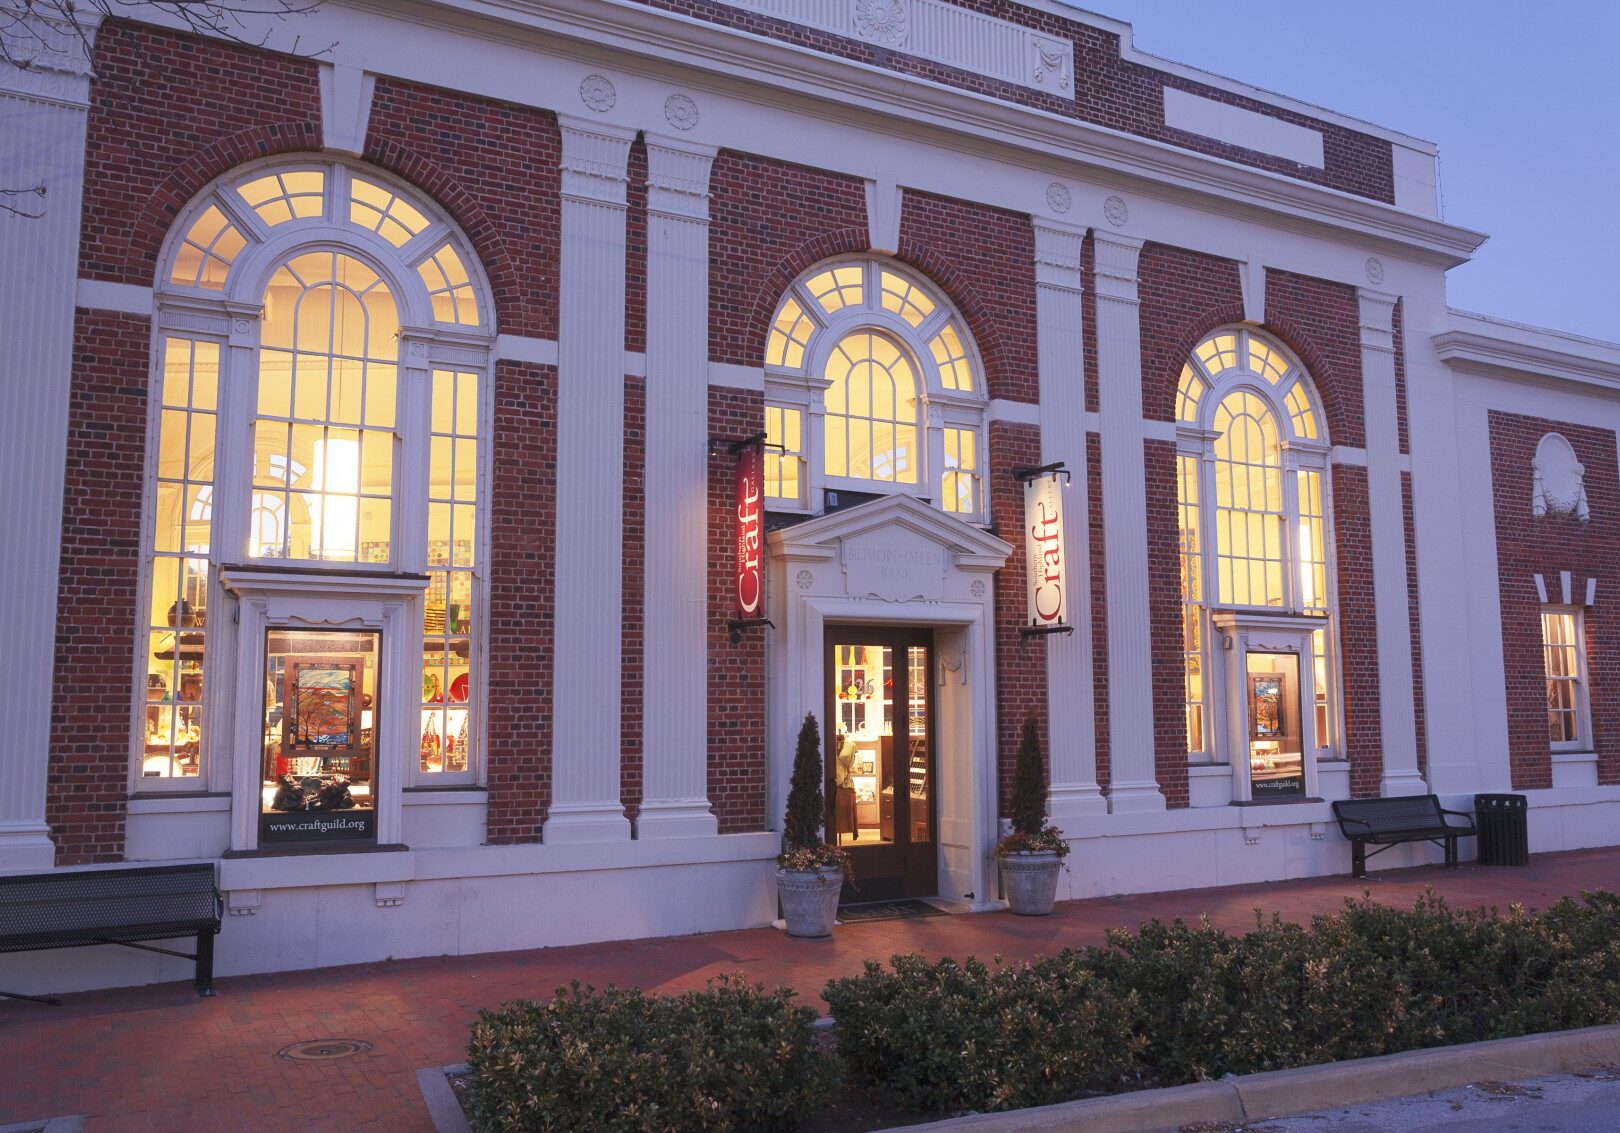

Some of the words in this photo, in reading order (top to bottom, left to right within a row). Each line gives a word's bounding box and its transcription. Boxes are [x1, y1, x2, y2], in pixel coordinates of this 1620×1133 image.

[738, 477, 759, 613] Craft
[881, 567, 911, 581] BANK
[1032, 501, 1061, 621] Craft
[269, 818, 365, 832] www.craftguild.org
